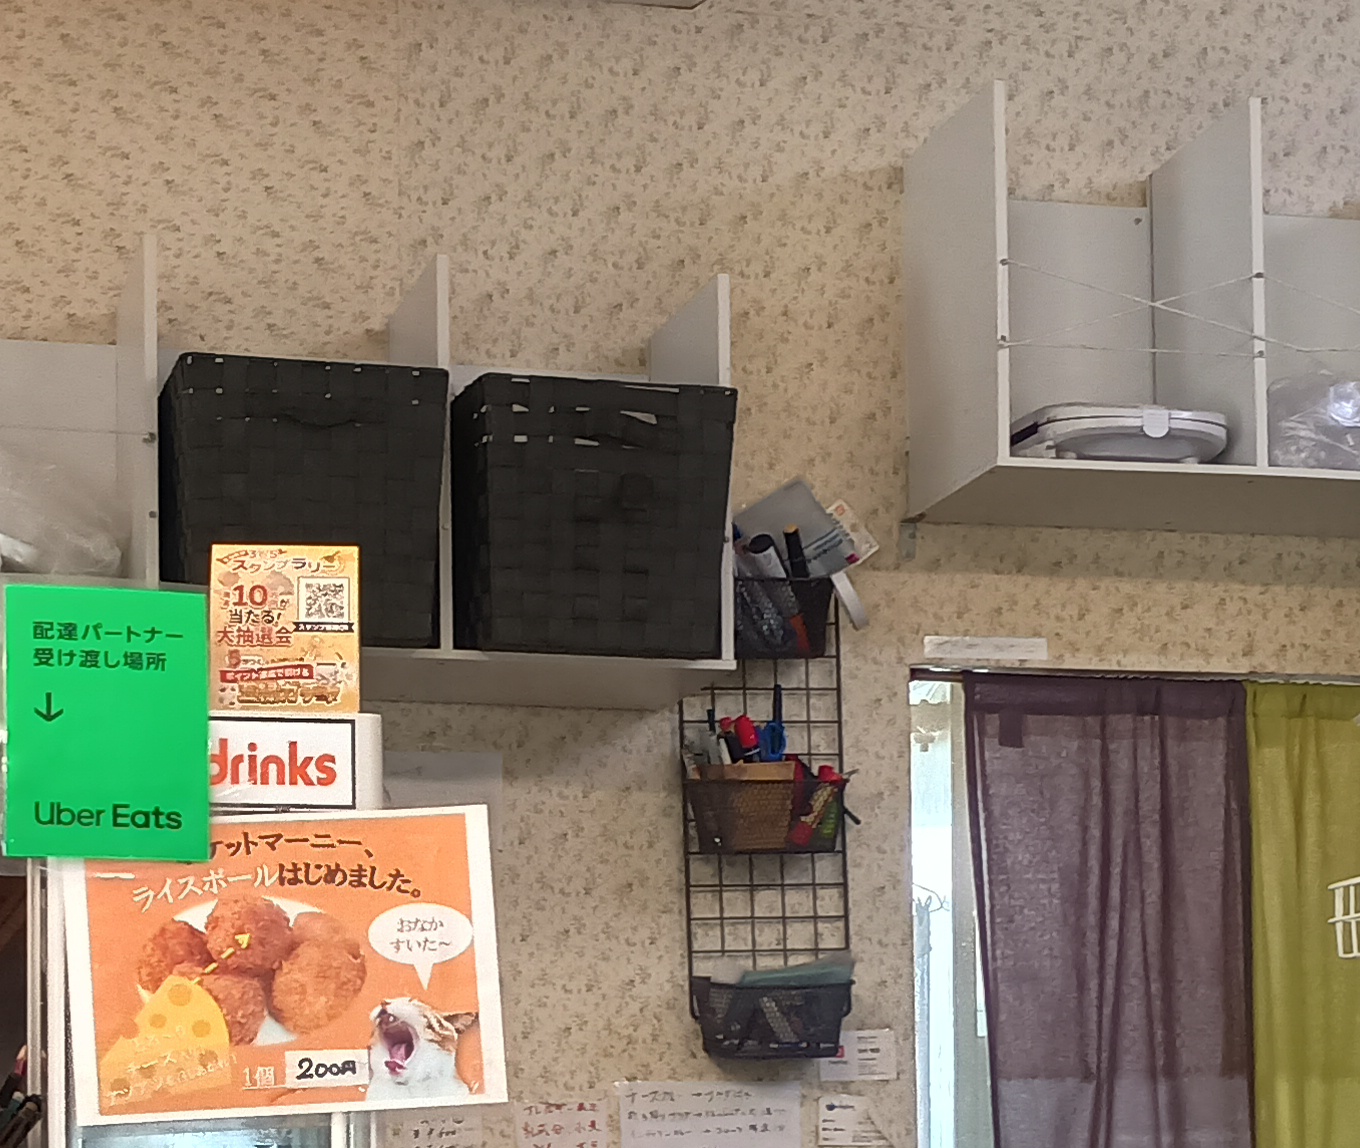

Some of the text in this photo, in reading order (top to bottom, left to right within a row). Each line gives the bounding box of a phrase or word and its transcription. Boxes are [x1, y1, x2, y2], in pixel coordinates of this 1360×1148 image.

[232, 584, 269, 607] 10
[31, 620, 185, 646] 配達パートナー
[31, 647, 168, 673] 受け渡し場所
[33, 800, 184, 832] Uber Eats
[297, 1057, 357, 1081] 200円
